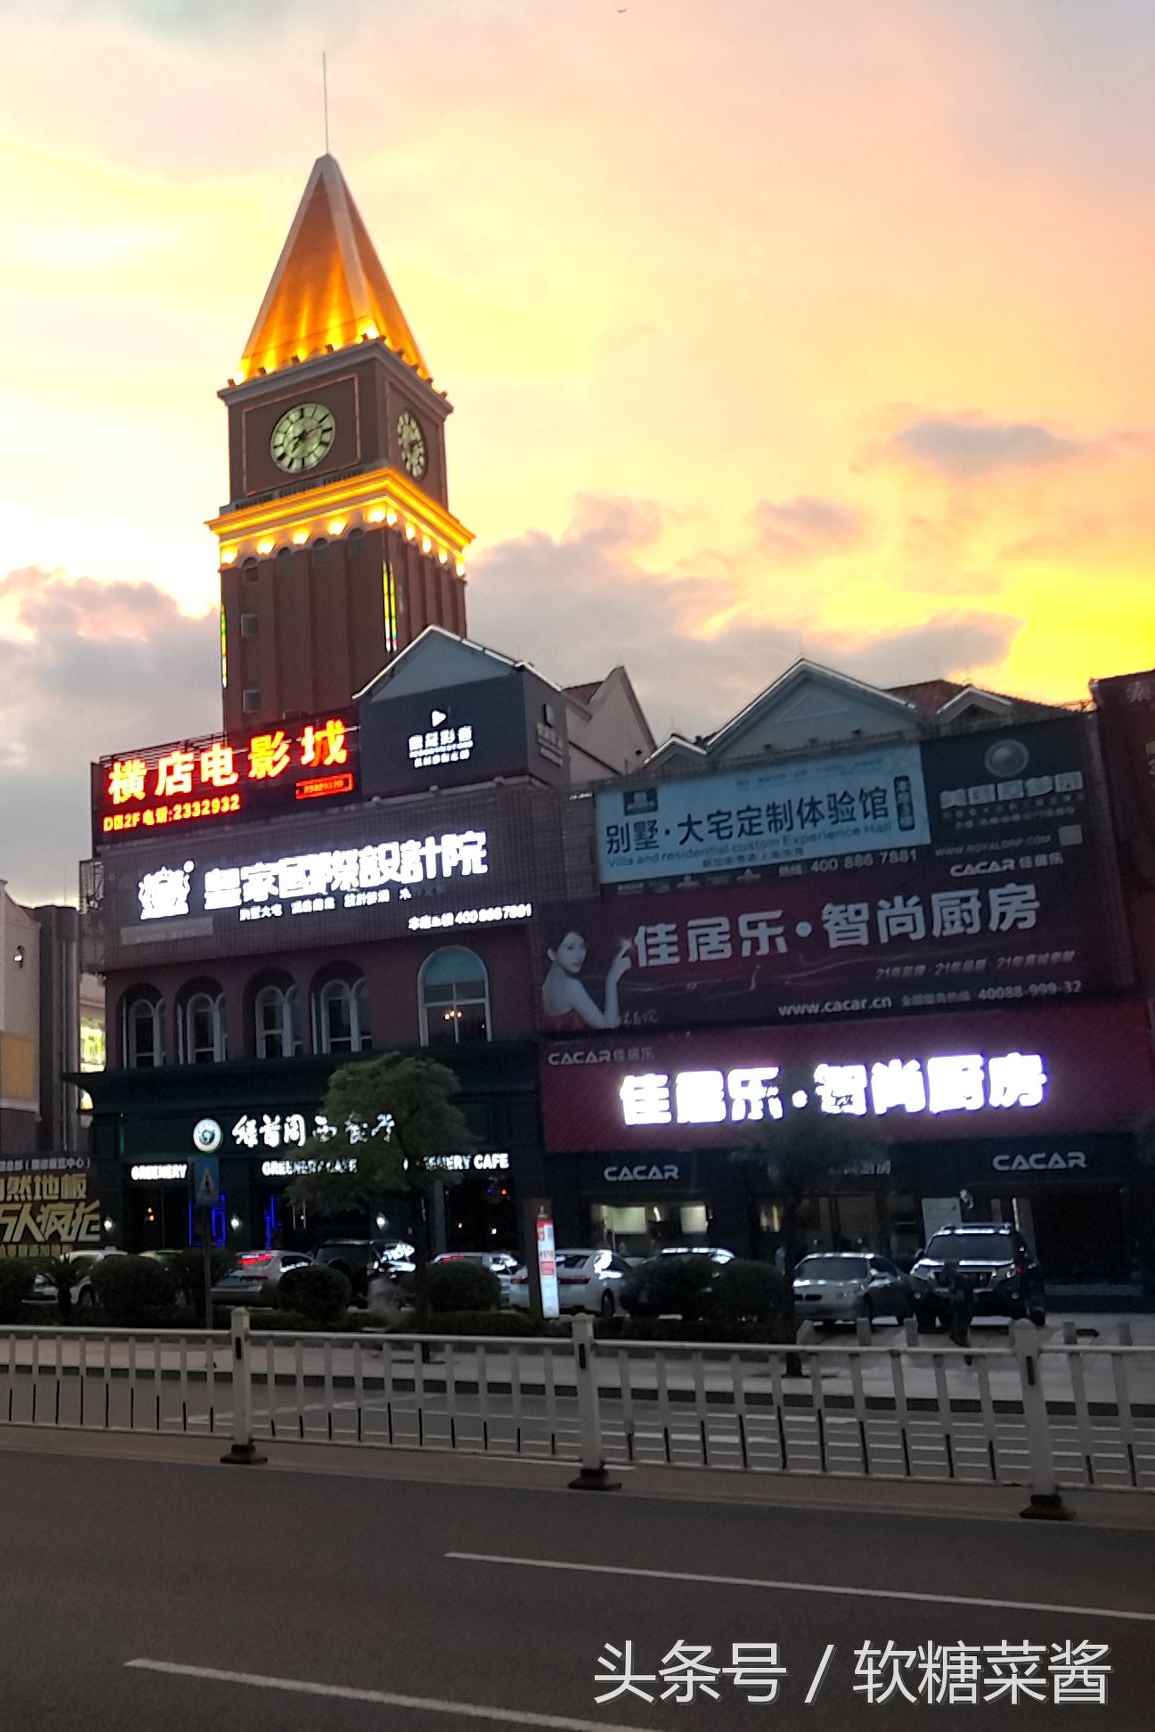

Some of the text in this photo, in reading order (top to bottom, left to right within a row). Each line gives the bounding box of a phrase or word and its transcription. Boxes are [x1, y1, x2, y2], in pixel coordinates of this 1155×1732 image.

[108, 719, 347, 804] 横店电影城
[606, 786, 891, 855] 别墅·大宅定制体验馆
[637, 852, 659, 866] and
[661, 842, 730, 863] residential
[731, 837, 780, 853] custom
[783, 826, 862, 848] Experience
[865, 821, 892, 836] Hall
[950, 858, 1015, 877] CACAR
[634, 882, 1042, 969] 佳居乐·智尚厨房
[778, 996, 892, 1017] www.cacar.cn
[548, 1050, 611, 1066] CACAR
[474, 1153, 509, 1170] CAFE
[992, 1151, 1087, 1172] CACAR
[604, 1164, 679, 1182] CACAR
